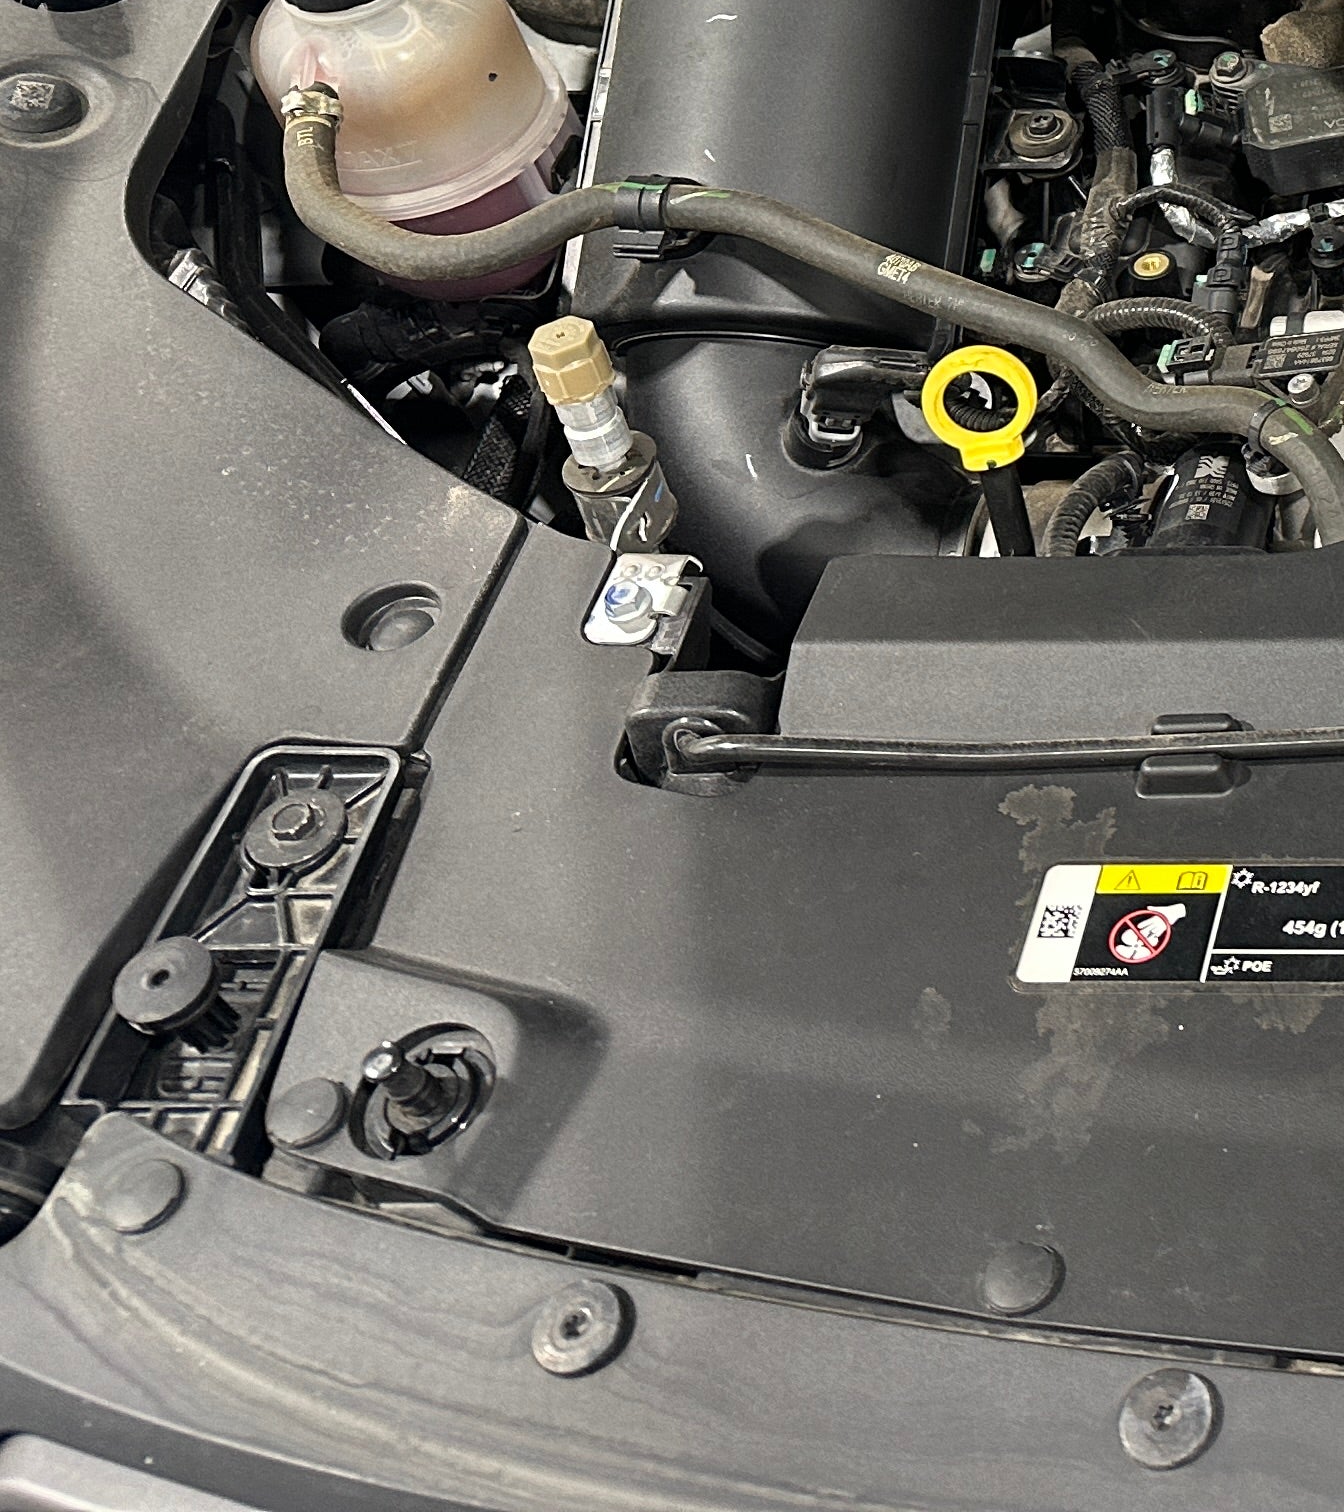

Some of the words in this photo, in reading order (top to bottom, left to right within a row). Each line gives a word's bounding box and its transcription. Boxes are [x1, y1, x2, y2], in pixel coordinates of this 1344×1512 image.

[1250, 880, 1321, 897] R-1234yf
[1282, 921, 1326, 939] 454g
[1242, 959, 1273, 973] POE
